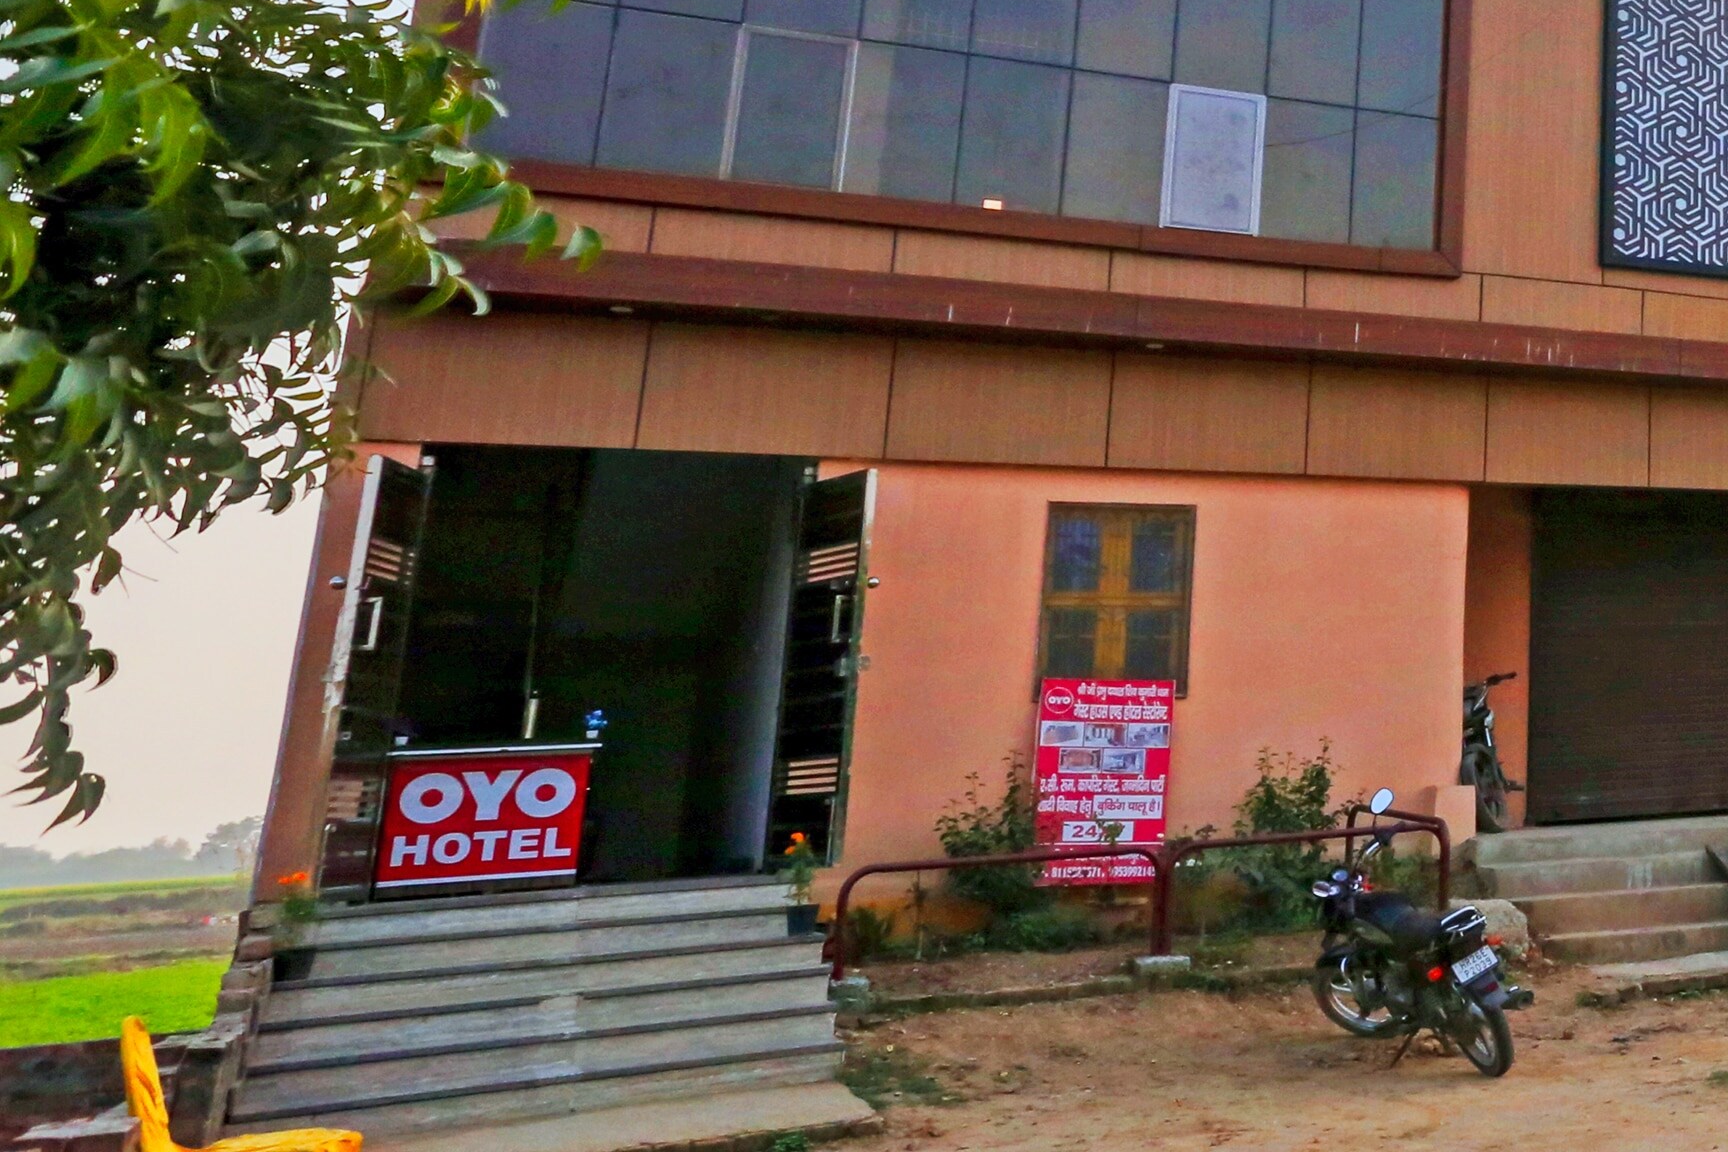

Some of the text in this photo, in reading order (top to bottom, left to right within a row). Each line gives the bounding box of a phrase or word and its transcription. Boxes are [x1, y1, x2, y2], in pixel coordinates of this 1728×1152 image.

[1048, 696, 1071, 704] OYO
[399, 768, 576, 824] OYO
[390, 827, 571, 867] HOTEL
